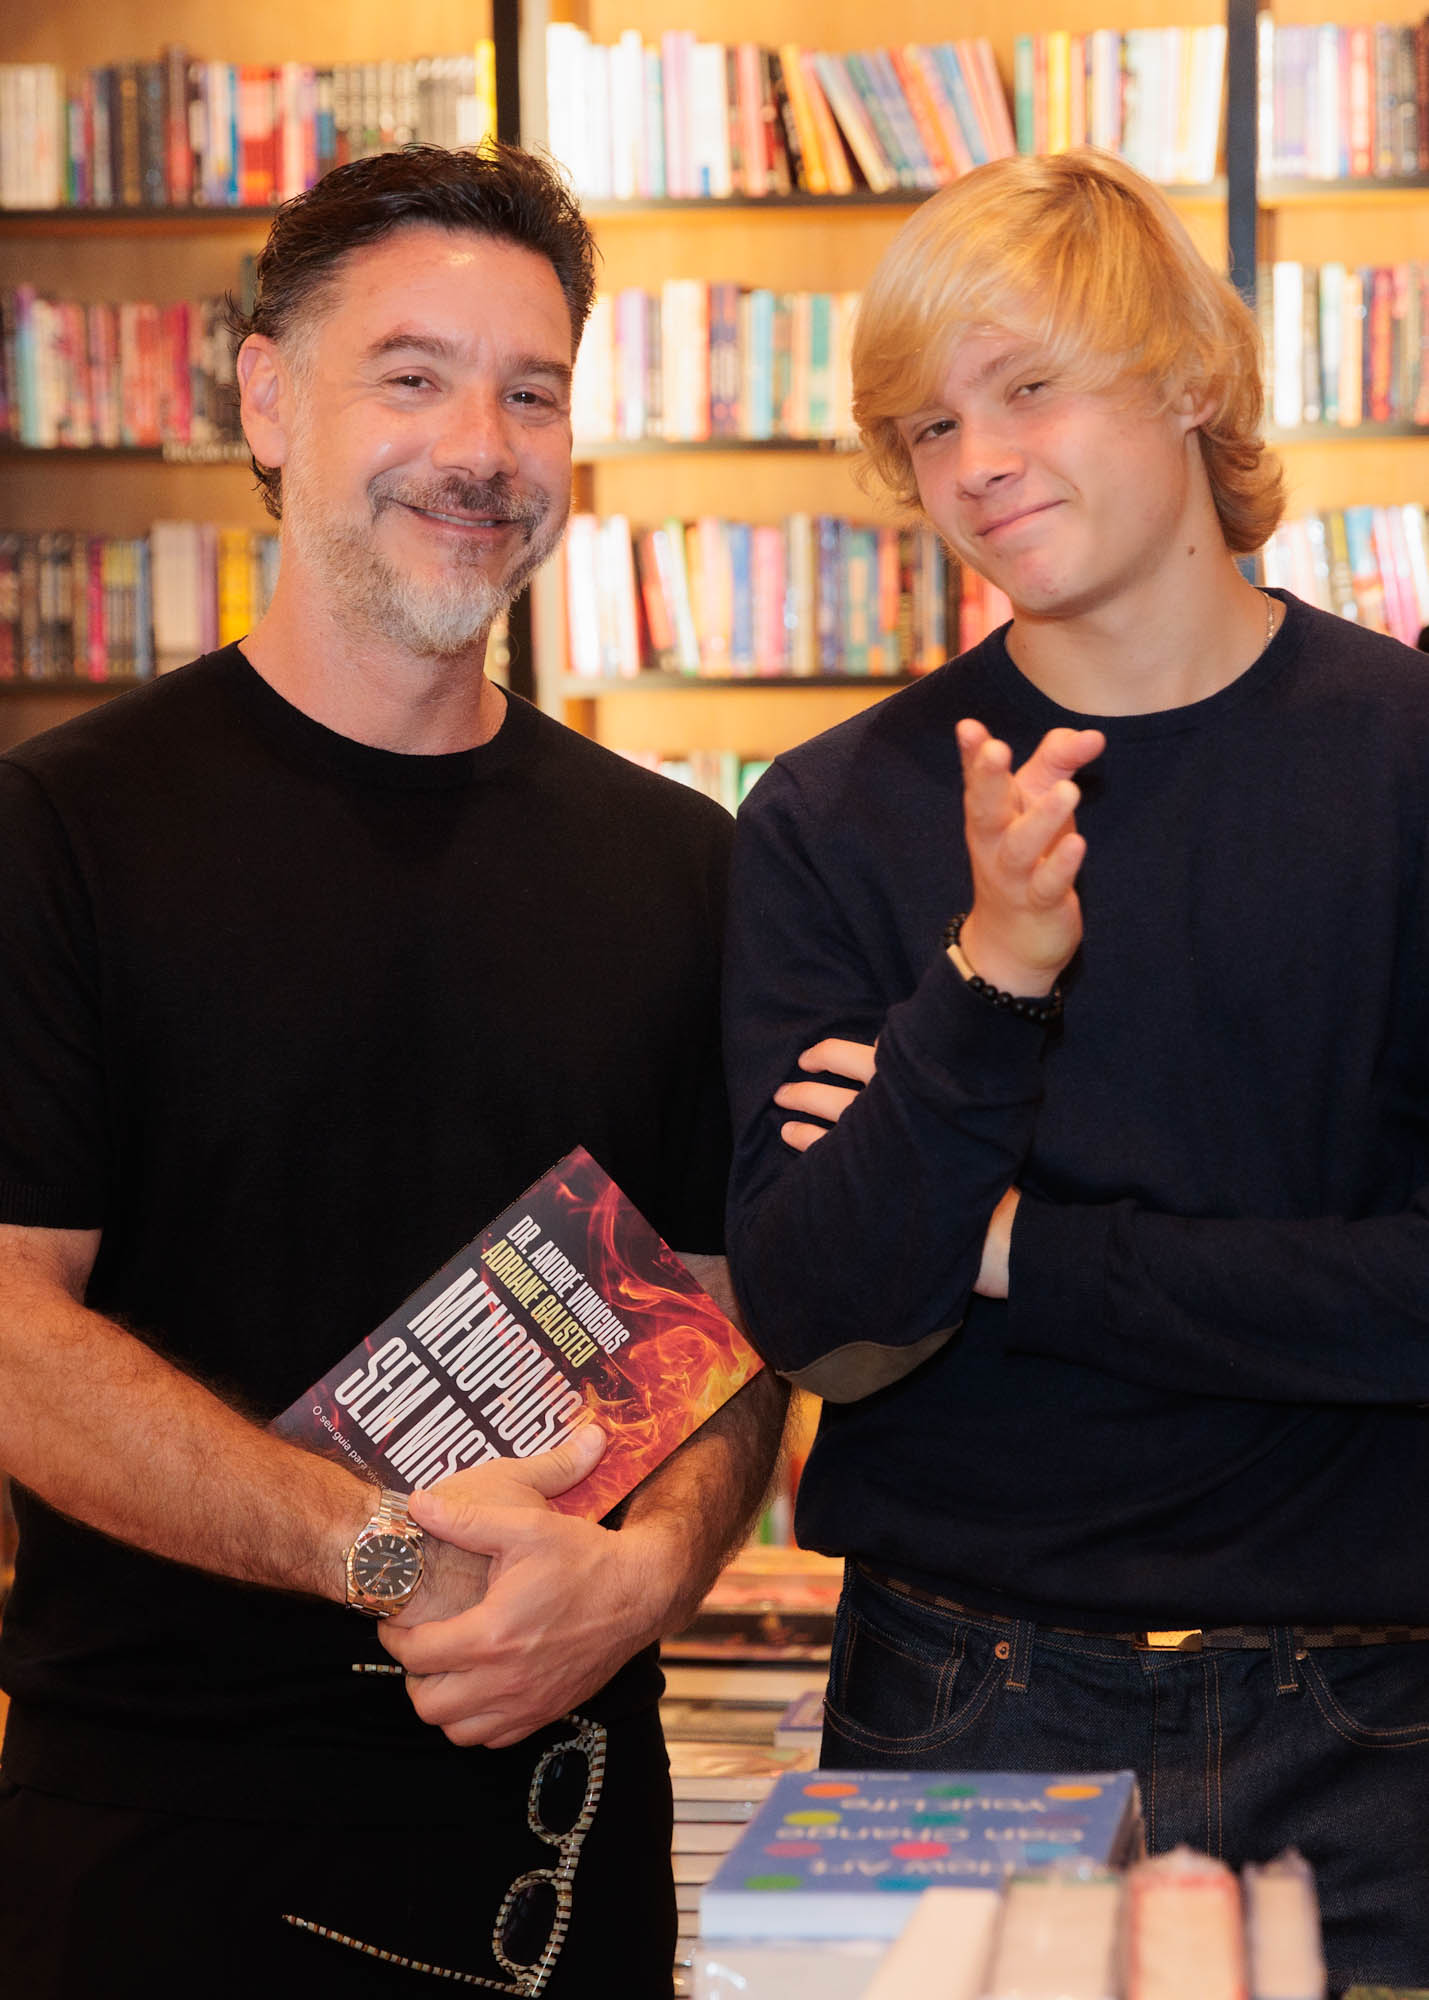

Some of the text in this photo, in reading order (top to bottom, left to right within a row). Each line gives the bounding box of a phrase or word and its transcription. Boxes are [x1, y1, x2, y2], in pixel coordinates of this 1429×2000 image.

[480, 1239, 598, 1368] ADRIANE GALISTEU
[506, 1215, 631, 1354] DR. ANDRÉ VINÍCIUS
[334, 1336, 441, 1444] SEM
[312, 1405, 322, 1415] O
[319, 1415, 336, 1433] seu
[332, 1431, 351, 1451] guia
[348, 1450, 368, 1470] para
[775, 1826, 1085, 1843] Can Change
[840, 1797, 1047, 1813] Your Life
[811, 1859, 1016, 1877] How Art
